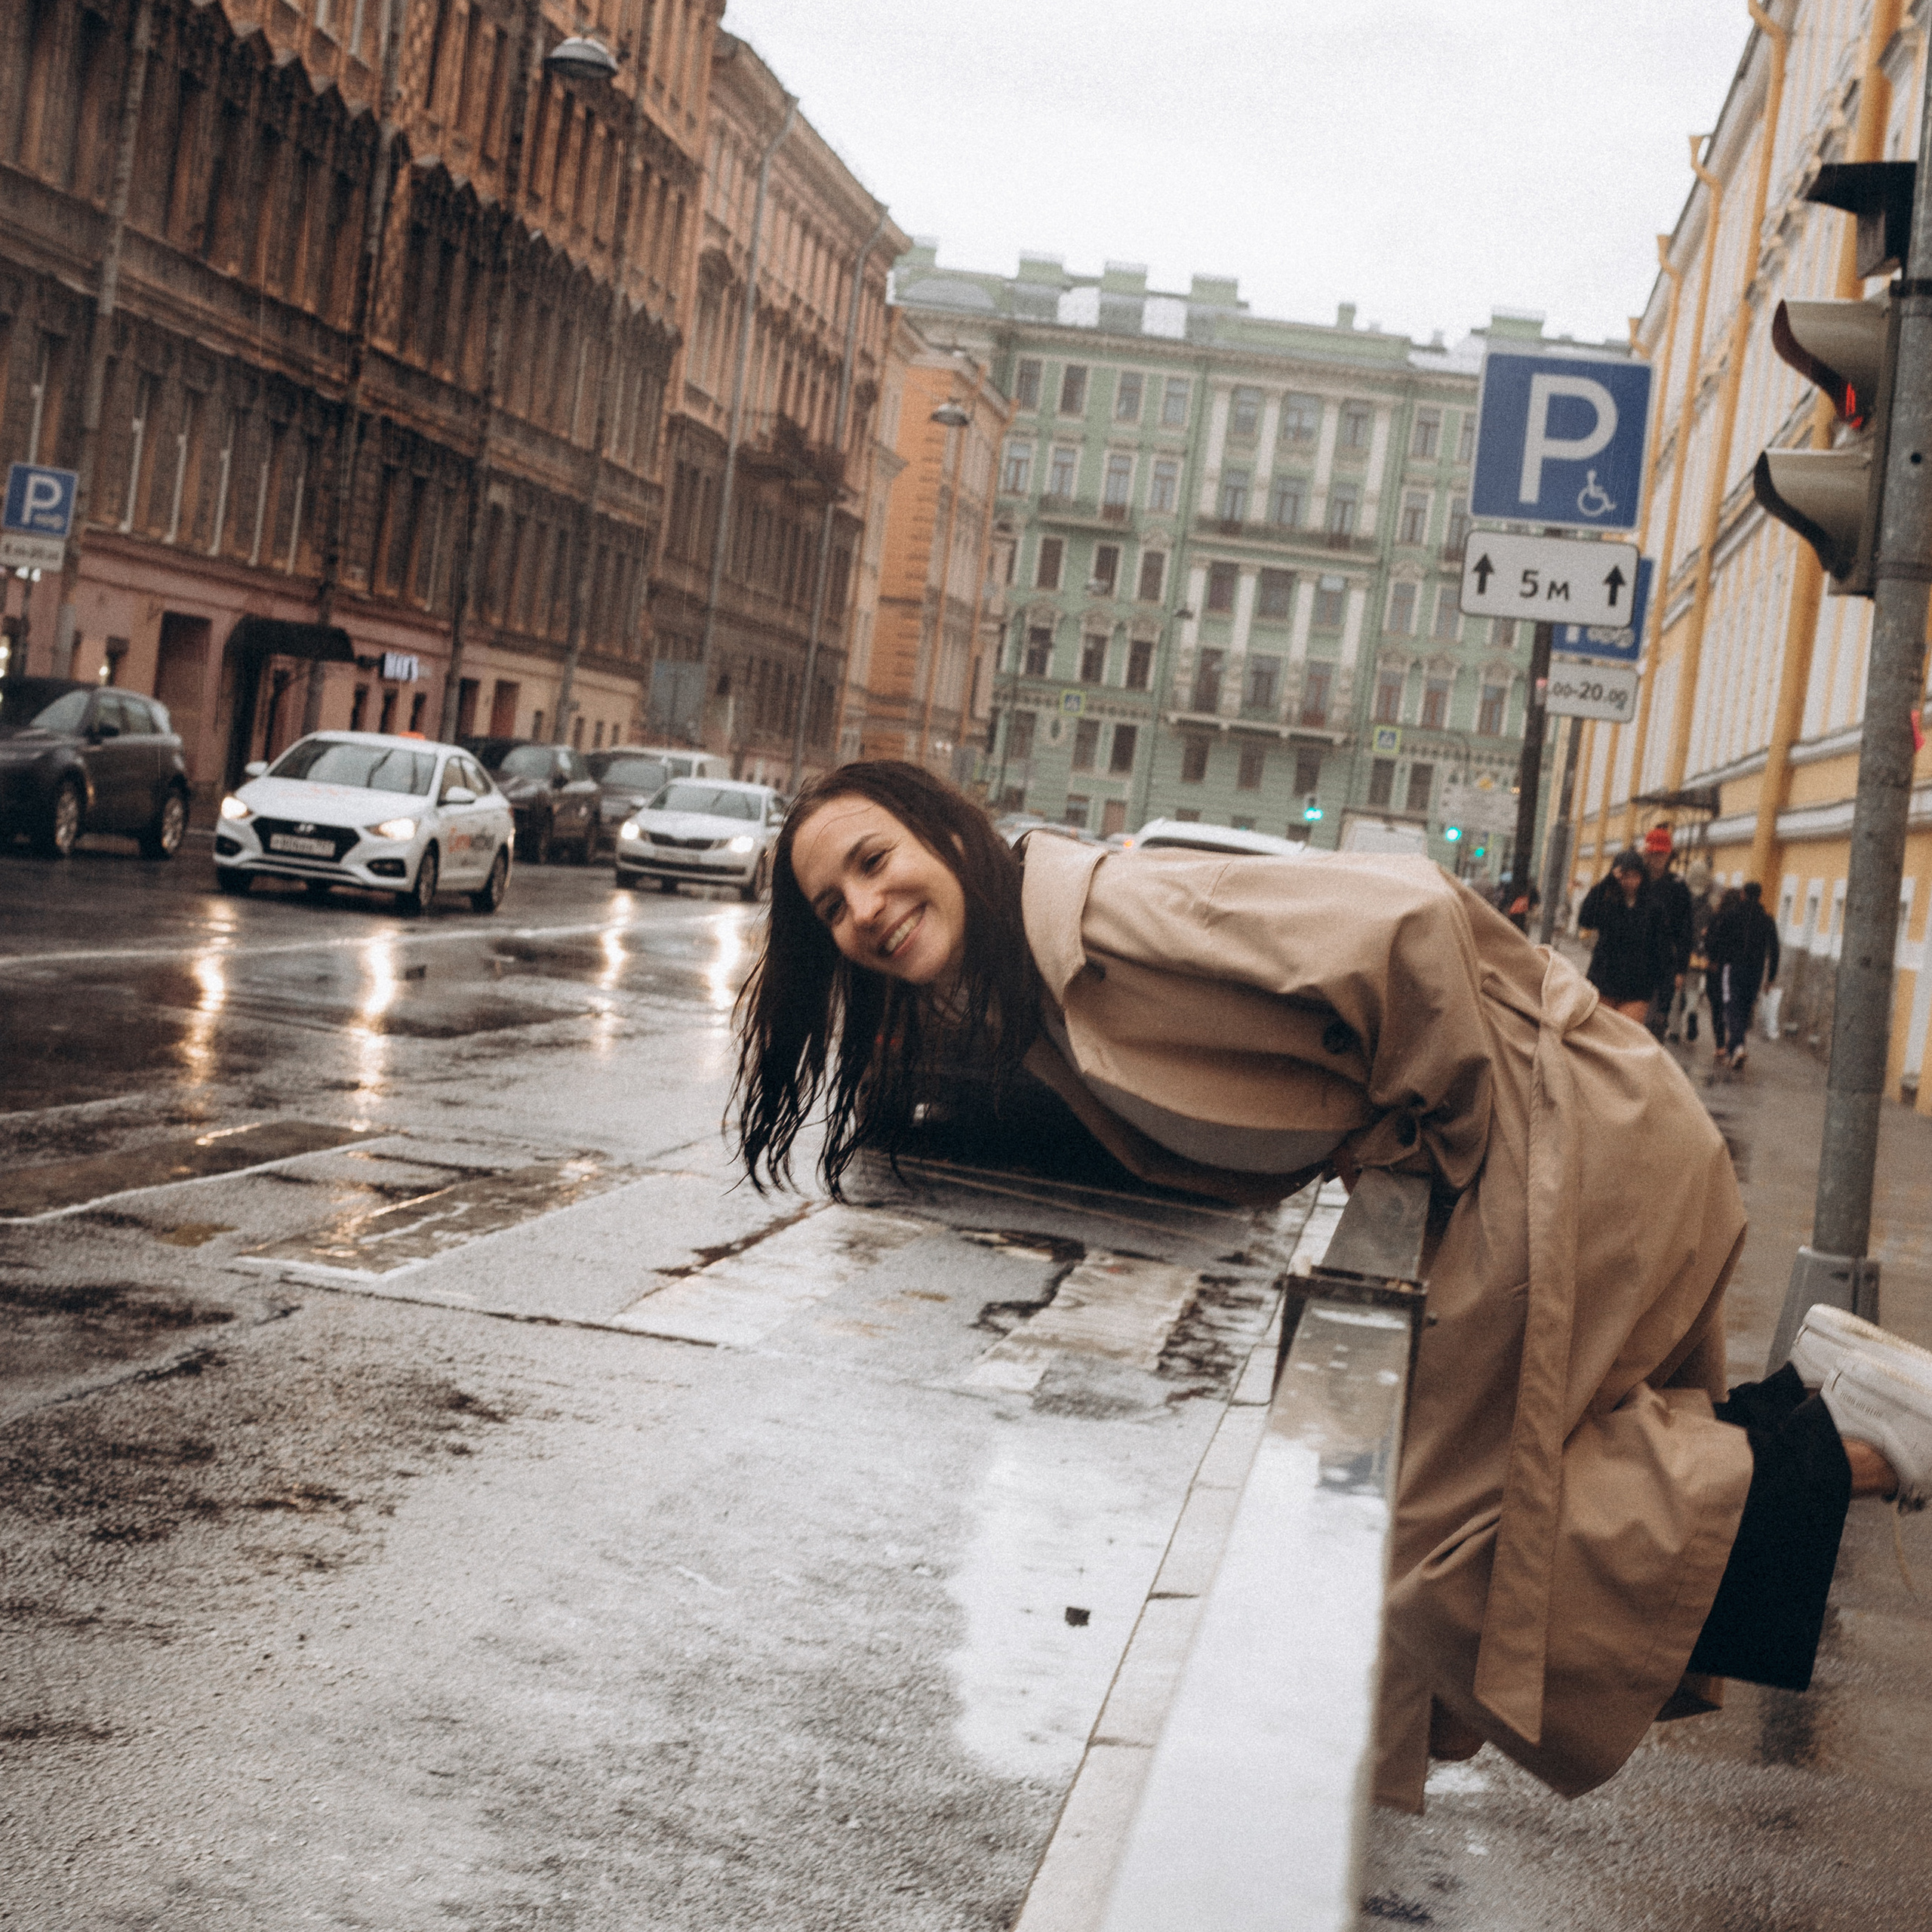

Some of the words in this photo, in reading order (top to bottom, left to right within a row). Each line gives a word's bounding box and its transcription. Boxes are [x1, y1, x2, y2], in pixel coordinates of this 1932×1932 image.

[1518, 373, 1619, 504] P
[21, 474, 63, 524] P
[1519, 569, 1540, 598] 5
